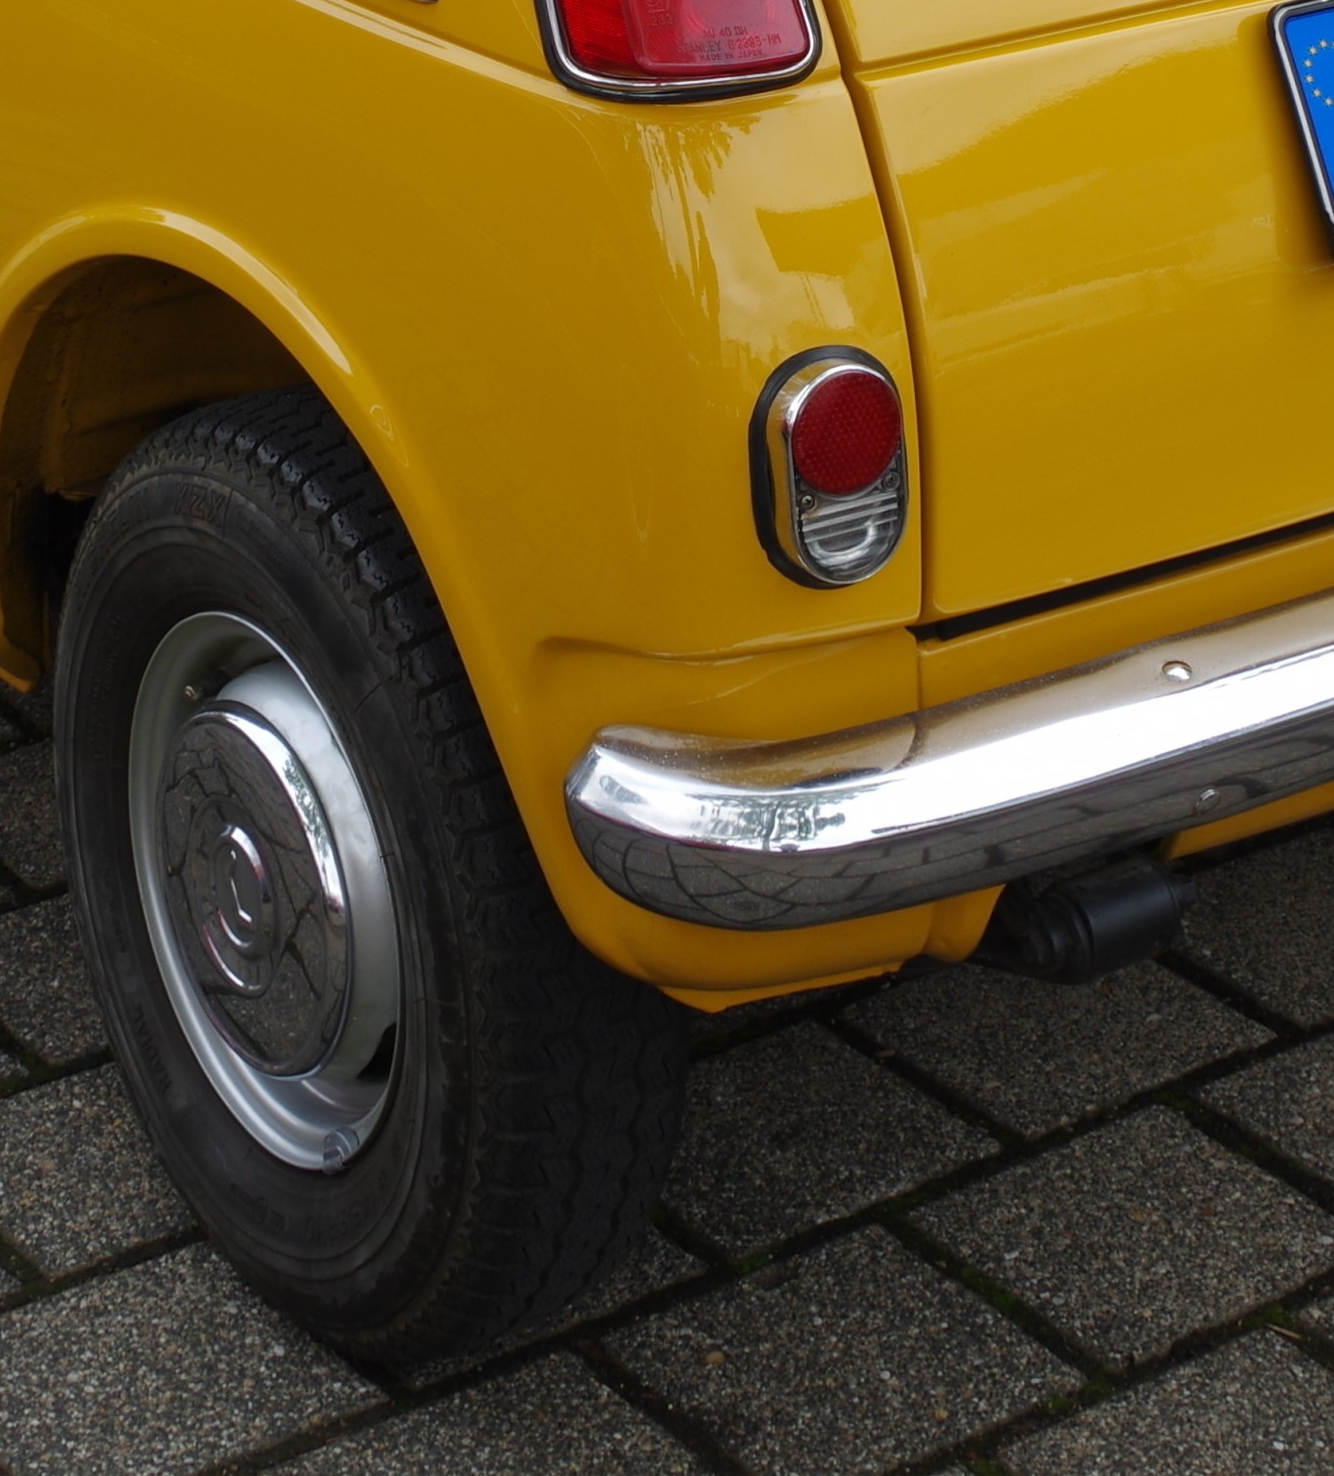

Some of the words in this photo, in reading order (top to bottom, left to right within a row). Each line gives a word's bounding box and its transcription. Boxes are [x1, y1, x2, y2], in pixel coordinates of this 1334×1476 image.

[677, 39, 722, 54] STANLEY
[700, 53, 723, 62] MADE
[724, 51, 734, 60] IN
[736, 49, 764, 59] JAPAN
